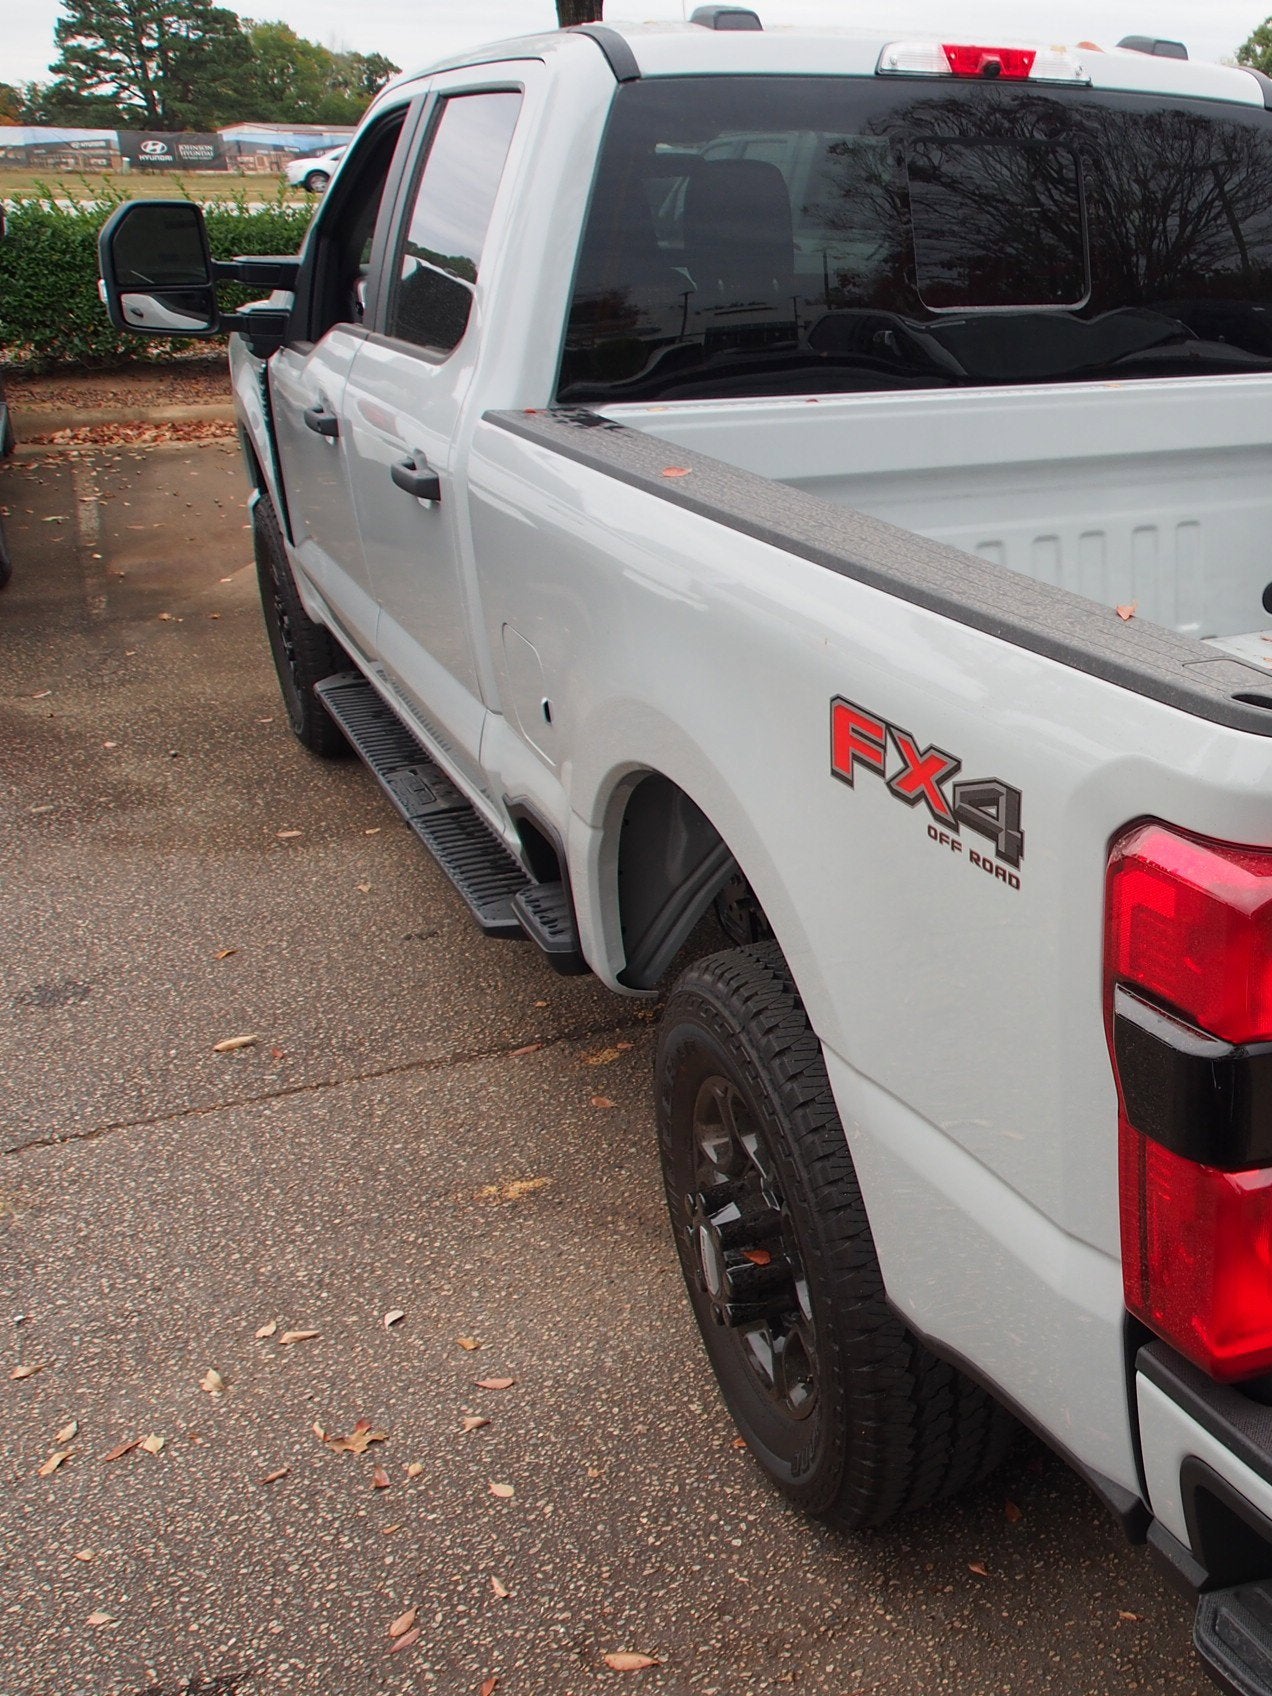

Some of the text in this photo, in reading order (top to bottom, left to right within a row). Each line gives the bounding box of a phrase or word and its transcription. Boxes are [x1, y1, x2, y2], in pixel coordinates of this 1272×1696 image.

[139, 154, 173, 162] HYUNDAI
[829, 693, 1025, 872] FX4
[927, 823, 1021, 891] OFF ROAD
